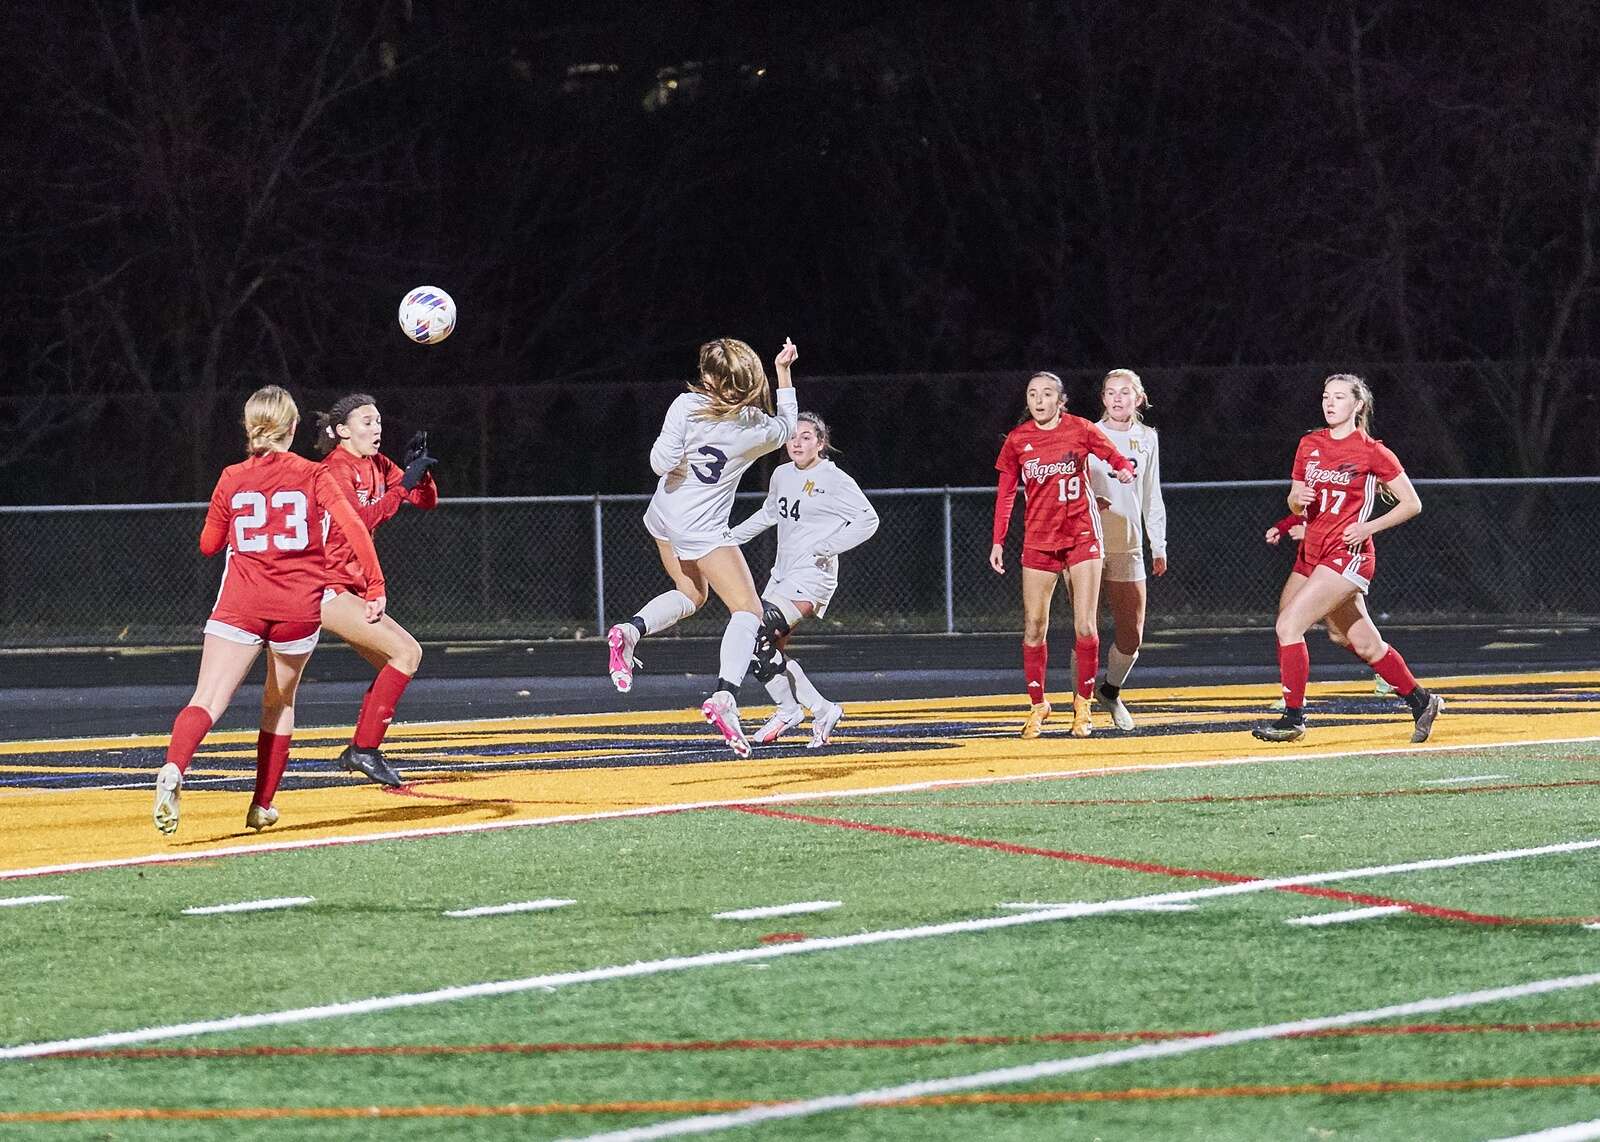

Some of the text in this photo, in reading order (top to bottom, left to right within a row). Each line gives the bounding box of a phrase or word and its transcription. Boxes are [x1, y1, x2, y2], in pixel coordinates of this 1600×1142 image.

[691, 445, 728, 484] 3
[1024, 458, 1076, 484] Tigers
[1058, 476, 1080, 501] 19
[1320, 488, 1347, 515] 17
[231, 491, 309, 552] 23
[778, 497, 800, 521] 34
